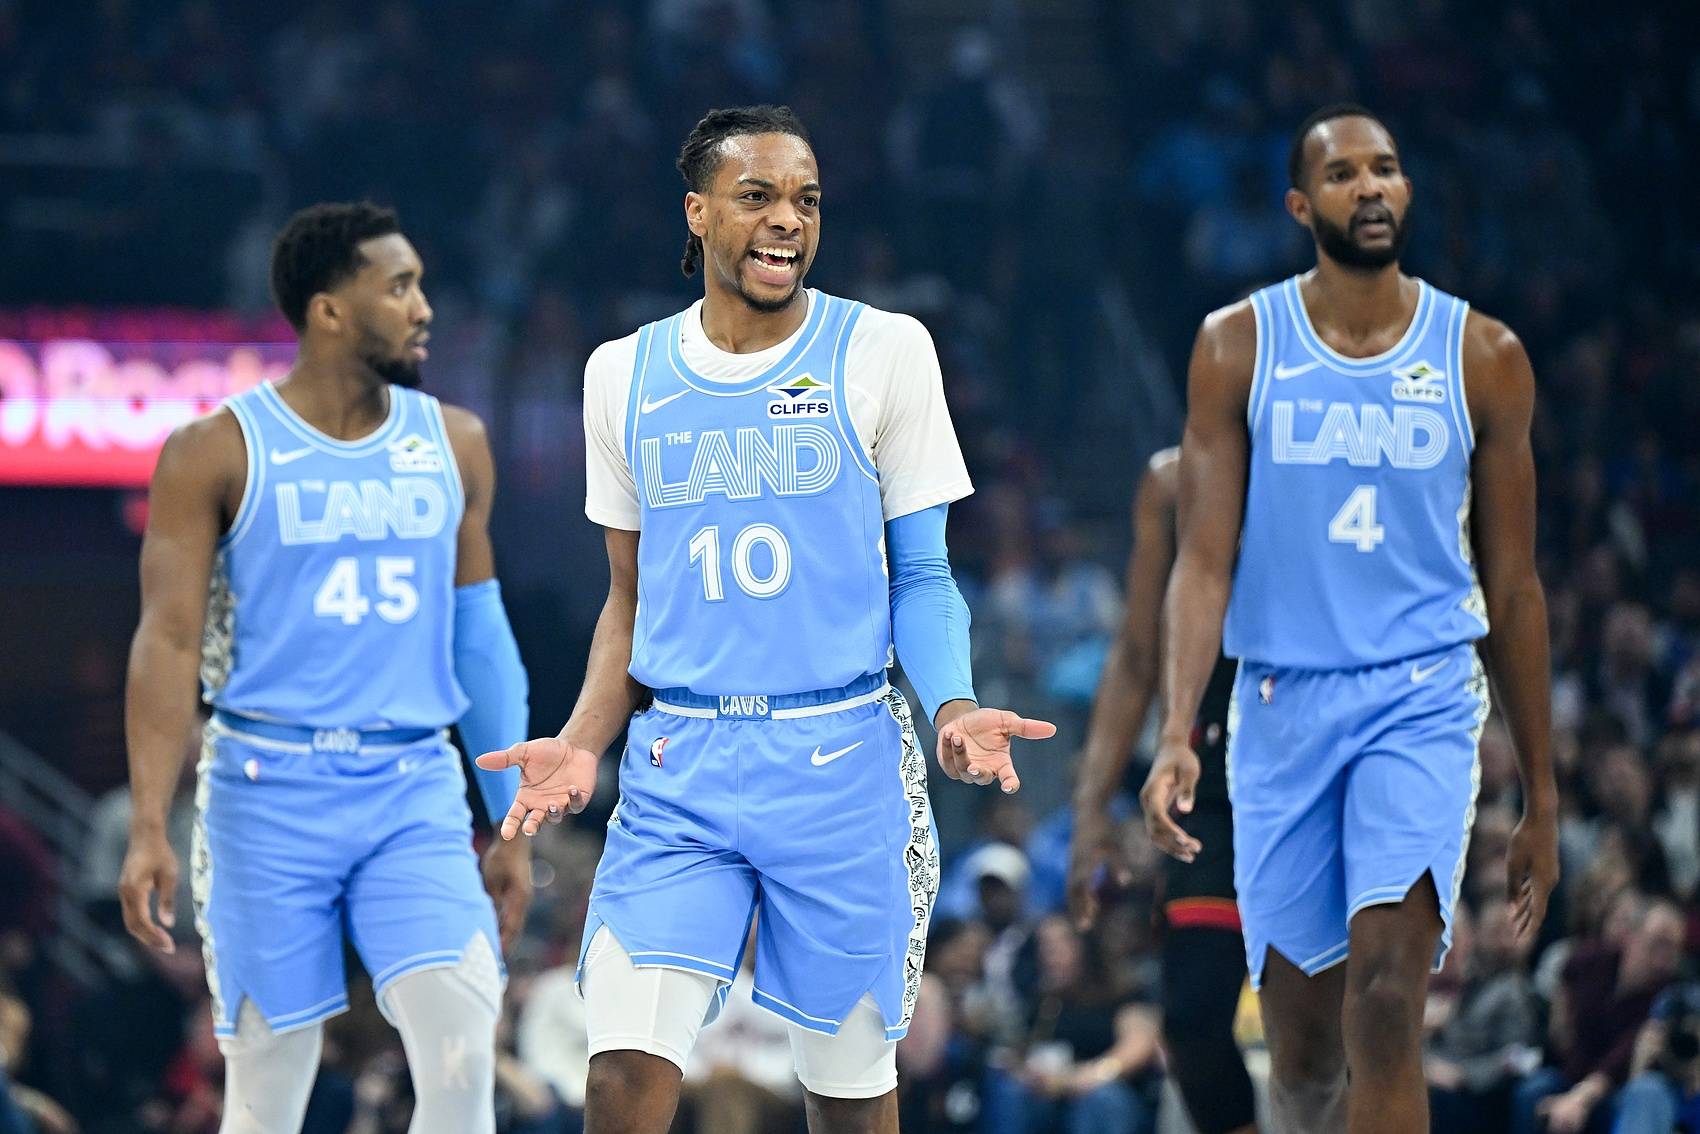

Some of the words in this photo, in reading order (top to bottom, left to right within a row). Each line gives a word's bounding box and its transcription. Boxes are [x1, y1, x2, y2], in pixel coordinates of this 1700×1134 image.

[665, 431, 692, 446] THE
[769, 402, 829, 415] CLIFFS
[1272, 400, 1449, 470] LAND
[640, 423, 841, 510] LAND
[275, 477, 449, 546] LAND
[1328, 484, 1385, 552] 4
[313, 556, 420, 625] 45
[688, 522, 793, 601] 10
[719, 695, 769, 716] CAVS
